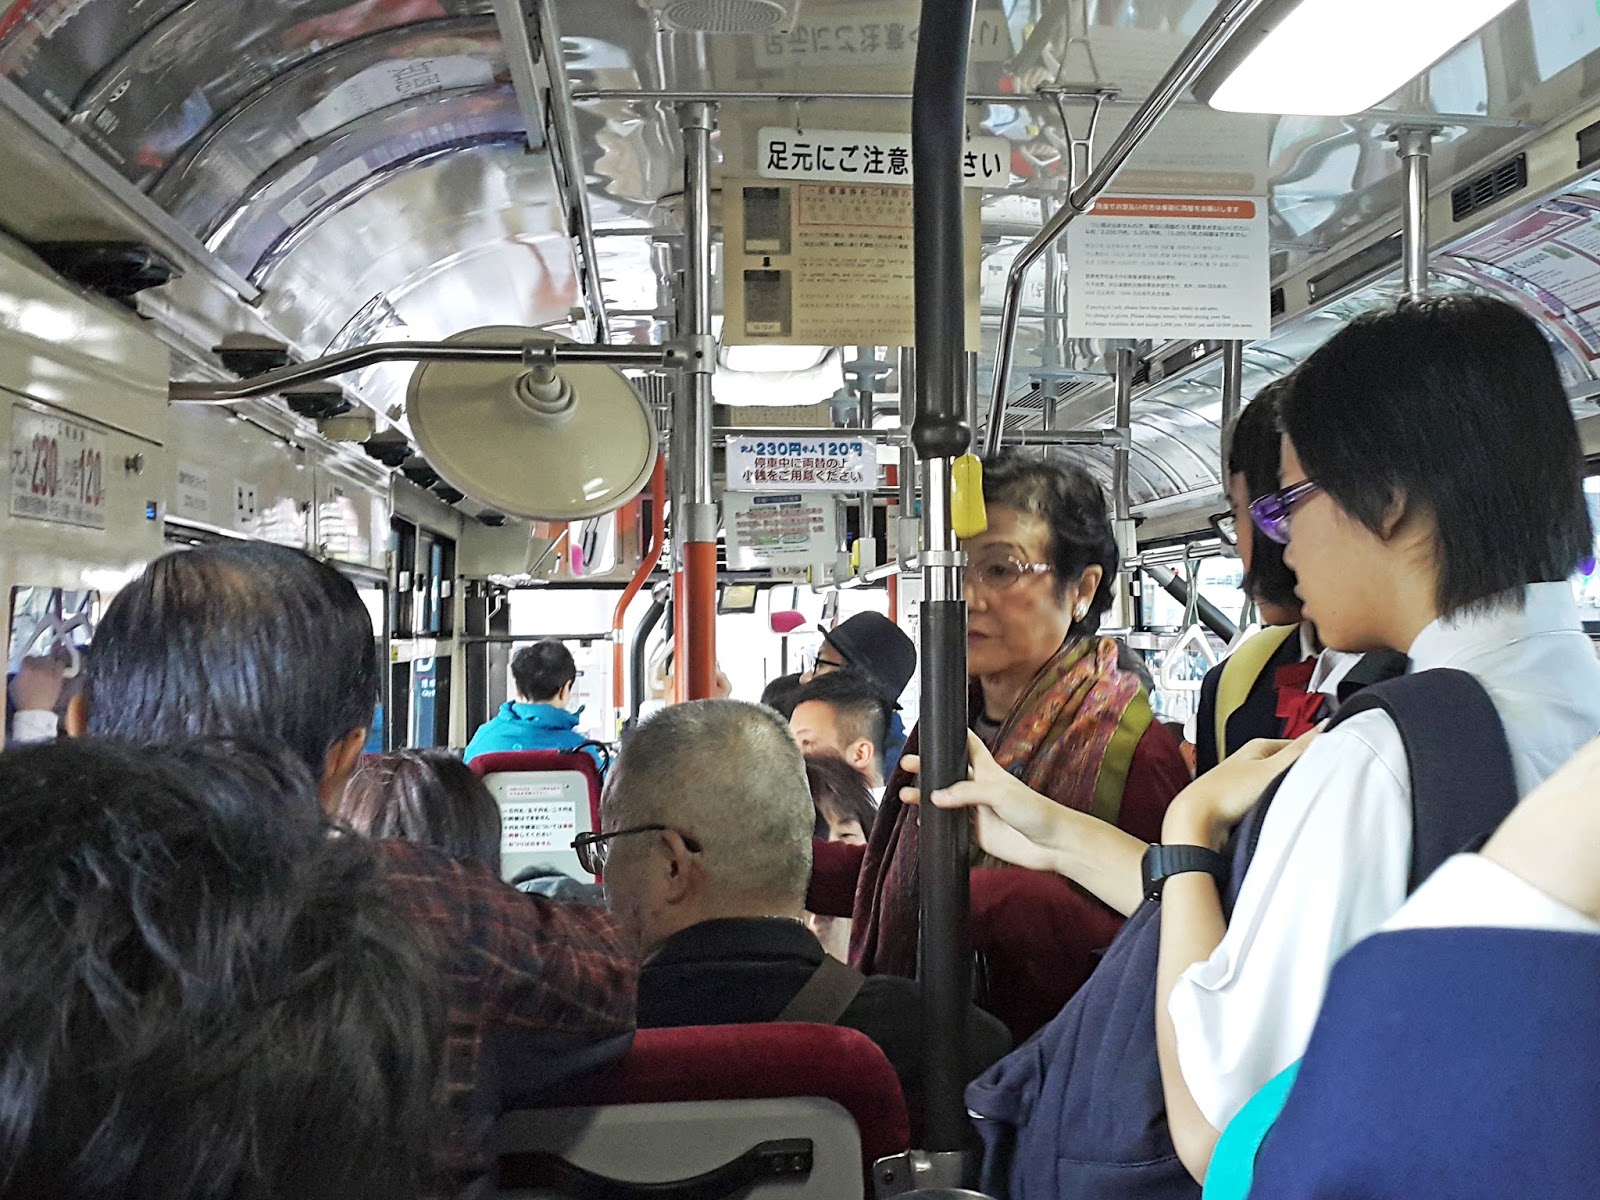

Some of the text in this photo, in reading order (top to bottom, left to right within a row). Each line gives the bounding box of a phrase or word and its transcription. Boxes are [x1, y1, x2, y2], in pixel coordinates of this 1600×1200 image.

[767, 140, 1001, 178] 足元にご注意さい
